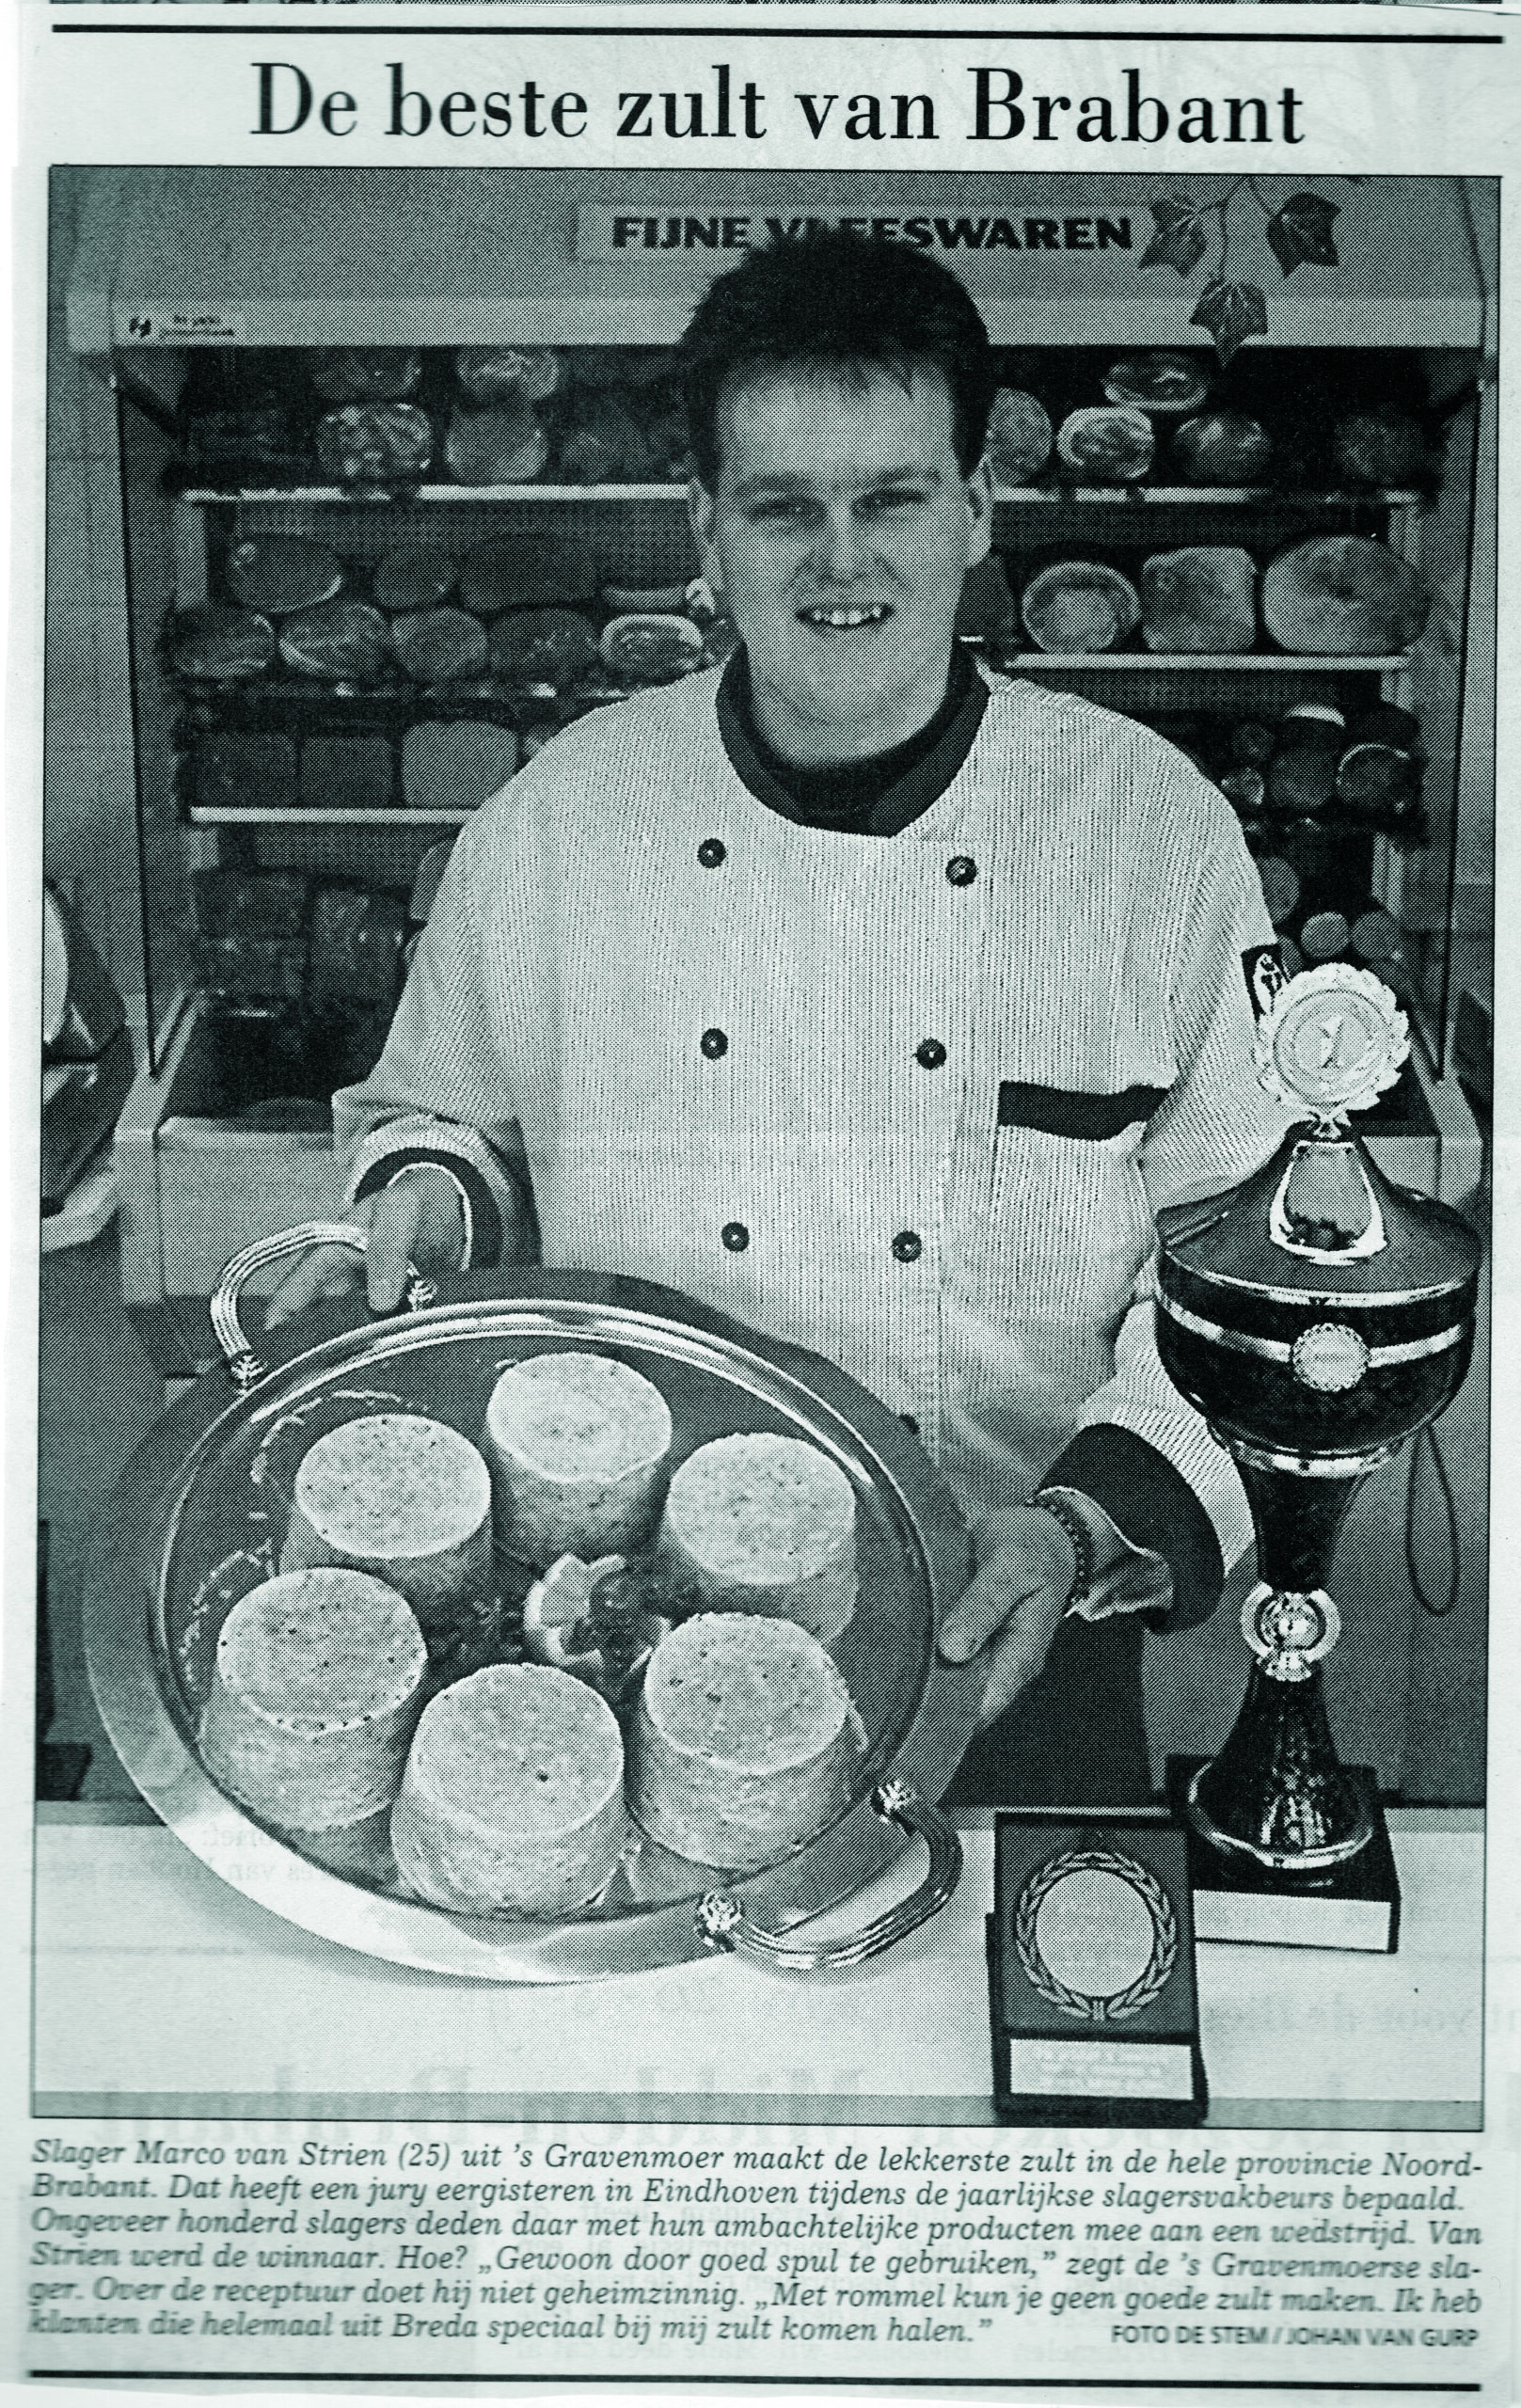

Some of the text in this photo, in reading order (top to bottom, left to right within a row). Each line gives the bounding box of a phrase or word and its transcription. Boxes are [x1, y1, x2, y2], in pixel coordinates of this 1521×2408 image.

[250, 62, 1305, 144] De beste zult van Brabant
[612, 216, 752, 249] FIJNE
[31, 2139, 127, 2170] Slager
[134, 2140, 226, 2164] Marco
[234, 2147, 289, 2165] van
[298, 2142, 388, 2166] Strien
[398, 2143, 451, 2171] (25)
[461, 2144, 503, 2167] uit
[544, 2144, 725, 2169] Gravenmoer
[733, 2145, 826, 2170] maakt
[834, 2146, 869, 2170] de
[878, 2147, 1011, 2172] lekkerste
[1019, 2147, 1077, 2172] zult
[1085, 2149, 1115, 2173] in
[1123, 2148, 1158, 2173] de
[1166, 2149, 1228, 2174] hele
[1234, 2151, 1372, 2181] provincie
[1380, 2151, 1483, 2177] Noord-
[29, 2173, 1465, 2217] Brabant. Dat heeft een jury eergisteren in Eindhoven tijdens de jaarlijkse slagersvakbeurs bepaald.
[30, 2208, 1482, 2250] Ongeveer honderd slagers deden daar met hun ambachtelijke producten mee aan een wedstrijd. Van
[29, 2242, 120, 2266] Strien
[130, 2242, 204, 2267] werd
[212, 2242, 248, 2267] de
[257, 2245, 385, 2268] winnaar.
[395, 2244, 468, 2269] Hoe?
[623, 2245, 692, 2271] door
[698, 2246, 768, 2278] goed
[776, 2248, 839, 2279] spul
[849, 2251, 877, 2273] te
[1065, 2255, 1127, 2282] zegt
[1134, 2250, 1170, 2275] de
[1212, 2252, 1421, 2277] Gravenmoerse
[1429, 2254, 1482, 2279] sla-
[27, 2282, 83, 2306] ger.
[93, 2276, 166, 2300] Over
[171, 2276, 206, 2301] de
[214, 2281, 356, 2308] receptuur
[362, 2278, 426, 2303] doet
[432, 2278, 472, 2310] hij
[480, 2280, 537, 2304] niet
[543, 2280, 745, 2312] geheimzinnig.
[835, 2282, 946, 2307] rommel
[952, 2283, 1009, 2308] kun
[1014, 2285, 1044, 2315] je
[1049, 2291, 1117, 2316] geen
[1122, 2285, 1209, 2317] goede
[1214, 2286, 1274, 2310] zult
[1280, 2287, 1385, 2311] maken.
[1392, 2288, 1424, 2313] Ik
[1431, 2288, 1482, 2313] heb
[28, 2309, 140, 2334] klanten
[149, 2310, 195, 2336] die
[200, 2310, 333, 2337] helemaal
[341, 2313, 383, 2337] uit
[390, 2312, 479, 2337] Breda
[486, 2313, 606, 2346] speciaal
[613, 2314, 651, 2345] bij
[660, 2316, 708, 2345] mij
[716, 2315, 773, 2339] zult
[780, 2316, 878, 2340] komen
[1111, 2325, 1170, 2343] FOTO
[1175, 2326, 1205, 2344] DE
[1210, 2326, 1269, 2344] STEM
[1285, 2327, 1361, 2345] JOHAN
[1366, 2328, 1414, 2346] VAN
[1419, 2328, 1480, 2347] GURP
